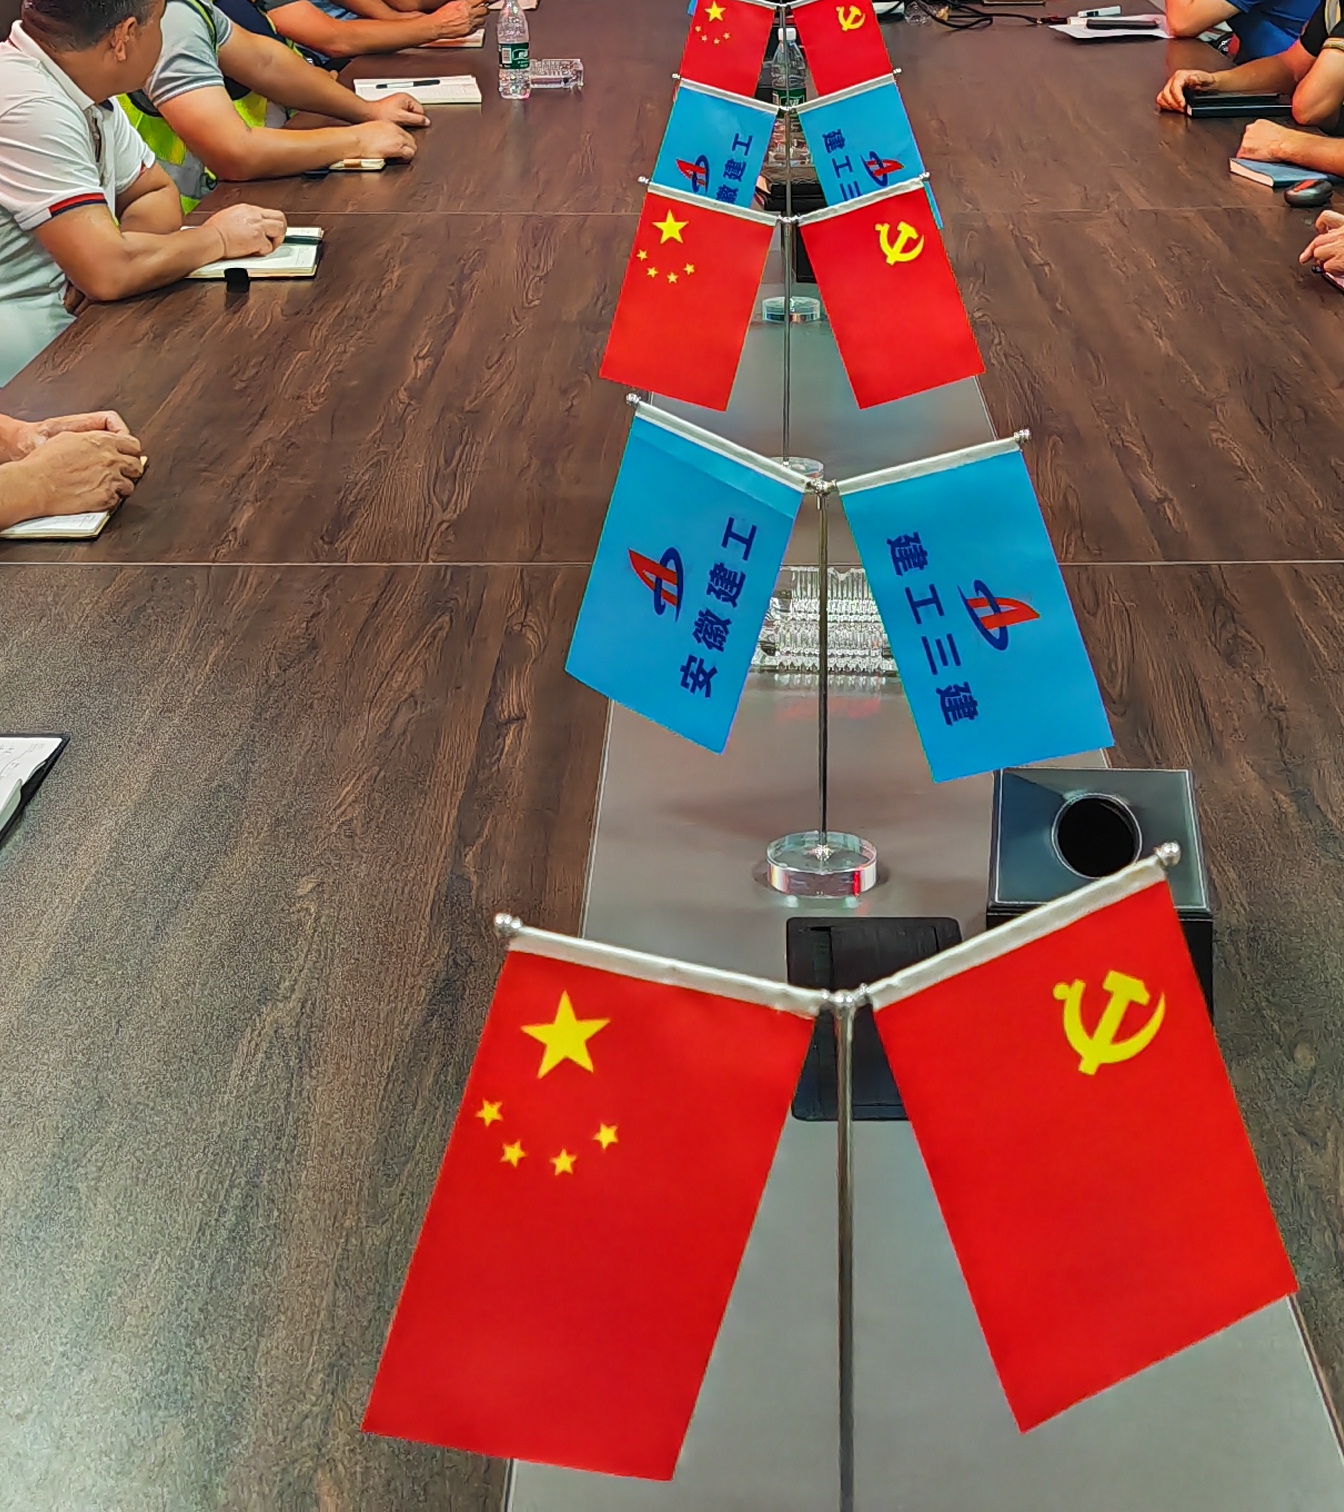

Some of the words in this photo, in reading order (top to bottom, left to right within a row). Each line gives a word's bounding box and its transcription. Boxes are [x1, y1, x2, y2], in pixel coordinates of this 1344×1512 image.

[679, 516, 757, 699] 安徽建工
[886, 531, 979, 727] 建工三建
